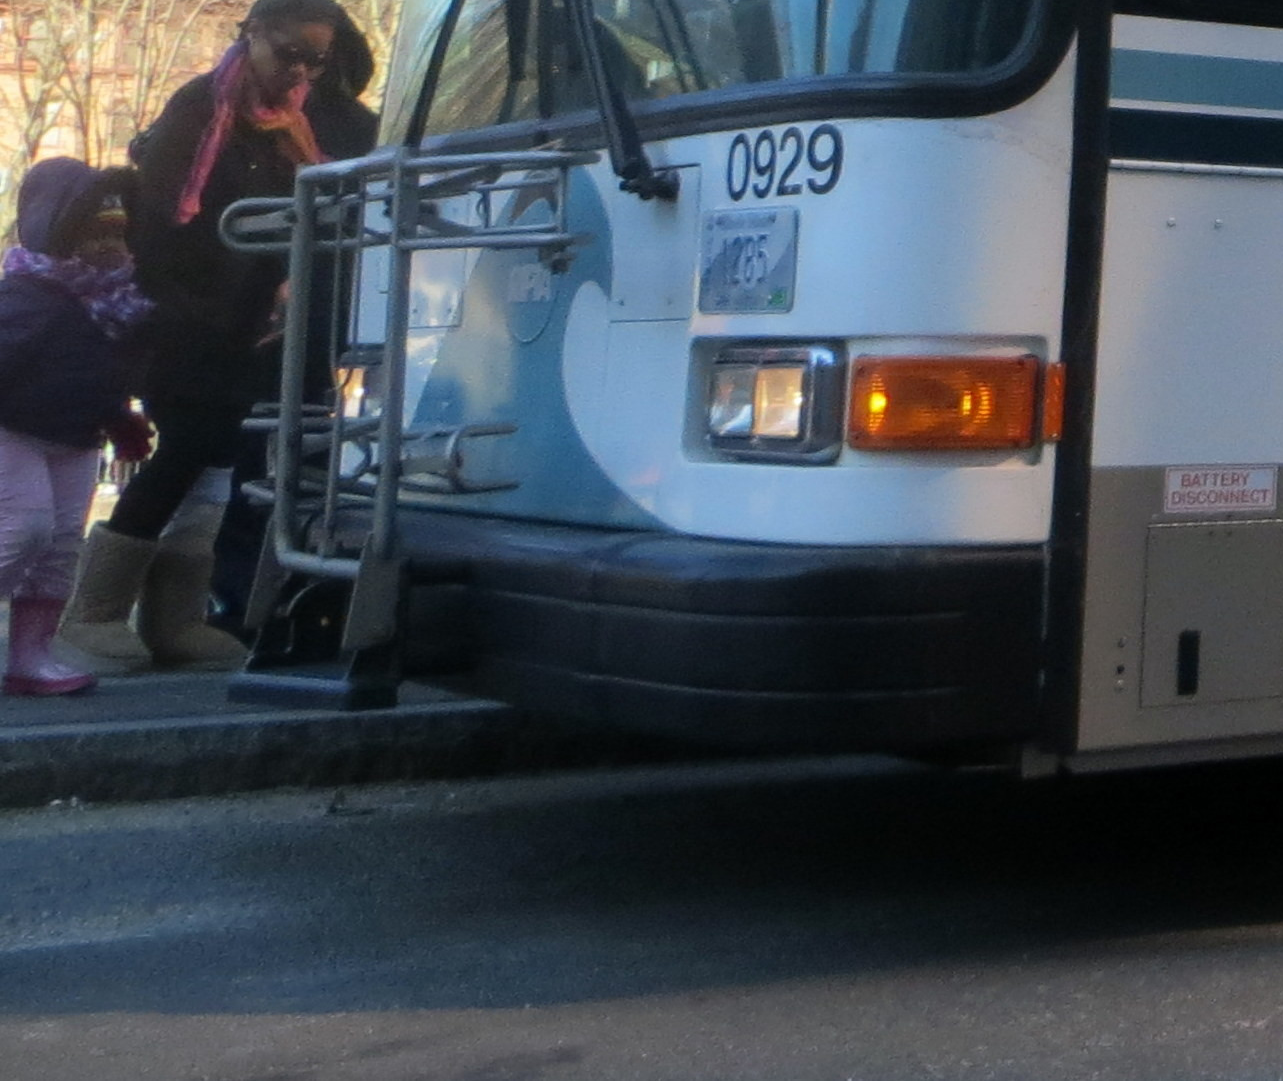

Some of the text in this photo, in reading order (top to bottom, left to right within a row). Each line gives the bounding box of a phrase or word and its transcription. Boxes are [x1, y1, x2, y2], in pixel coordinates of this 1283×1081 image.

[727, 124, 844, 202] 0929
[1181, 473, 1249, 487] BATTERY
[1171, 489, 1270, 505] DISCONNECT
